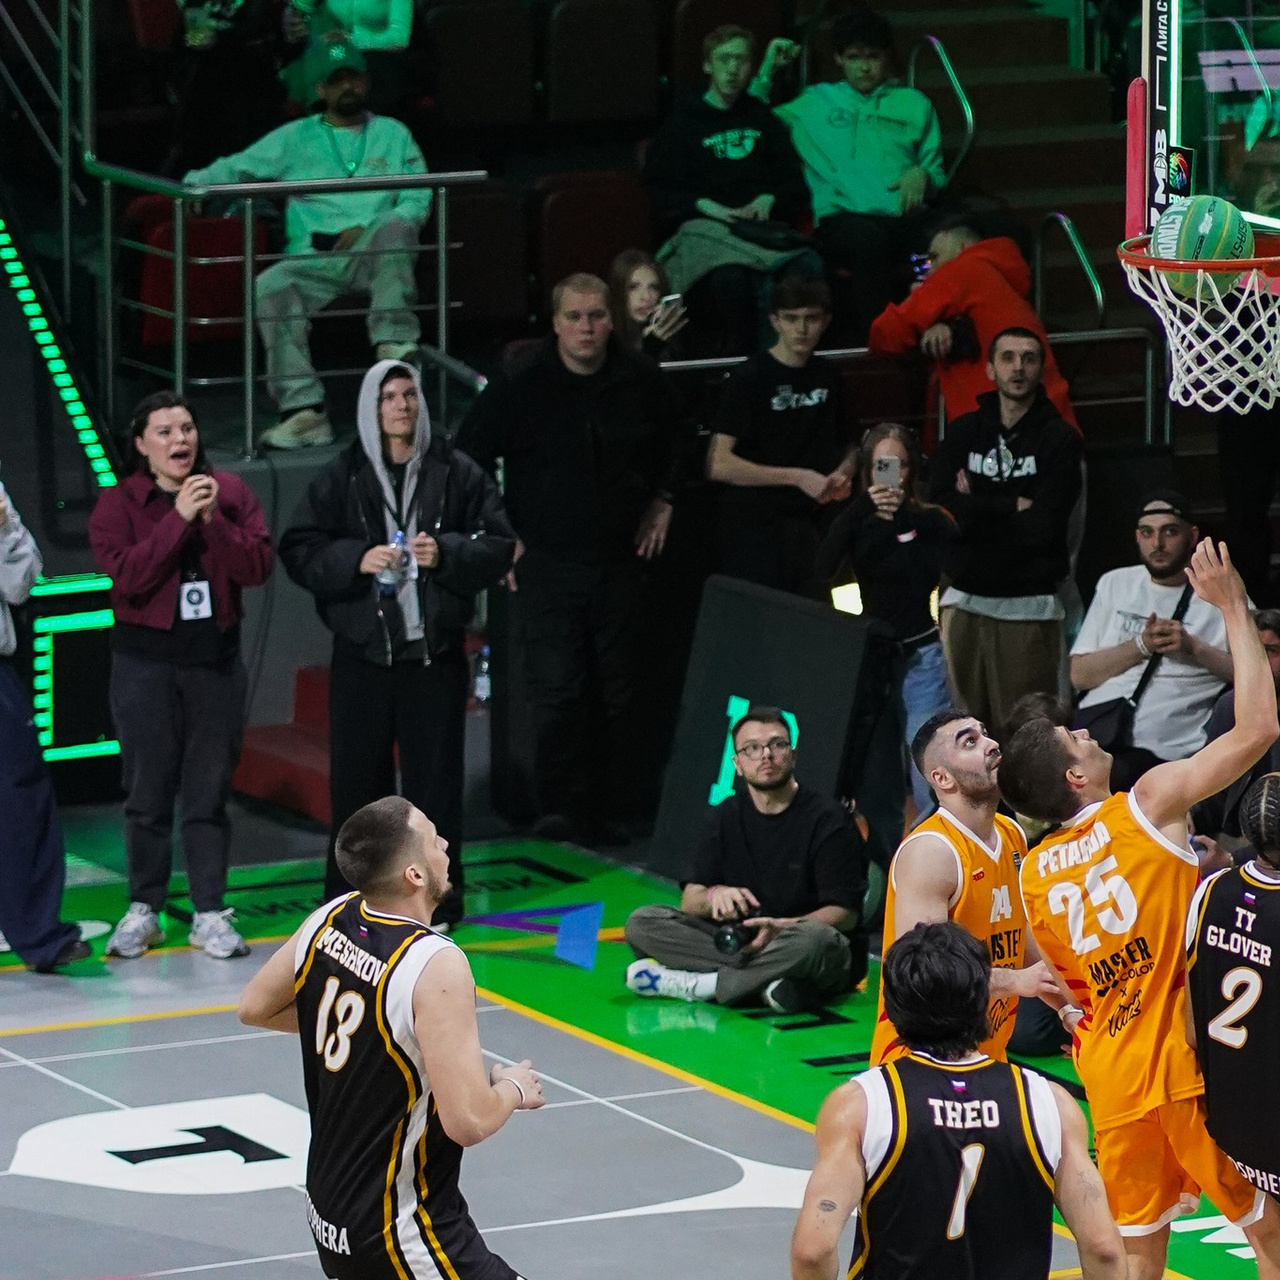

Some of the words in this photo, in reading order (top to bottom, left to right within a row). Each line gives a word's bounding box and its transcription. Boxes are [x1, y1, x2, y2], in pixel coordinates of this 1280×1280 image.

[989, 884, 1012, 924] 24
[1047, 854, 1138, 955] 25
[1235, 906, 1257, 932] TY
[305, 926, 388, 987] MESHKOV
[1206, 925, 1273, 966] GLOVER
[316, 975, 366, 1072] 13
[1208, 966, 1263, 1049] 2
[928, 1098, 1000, 1129] THEO
[946, 1142, 985, 1240] 1
